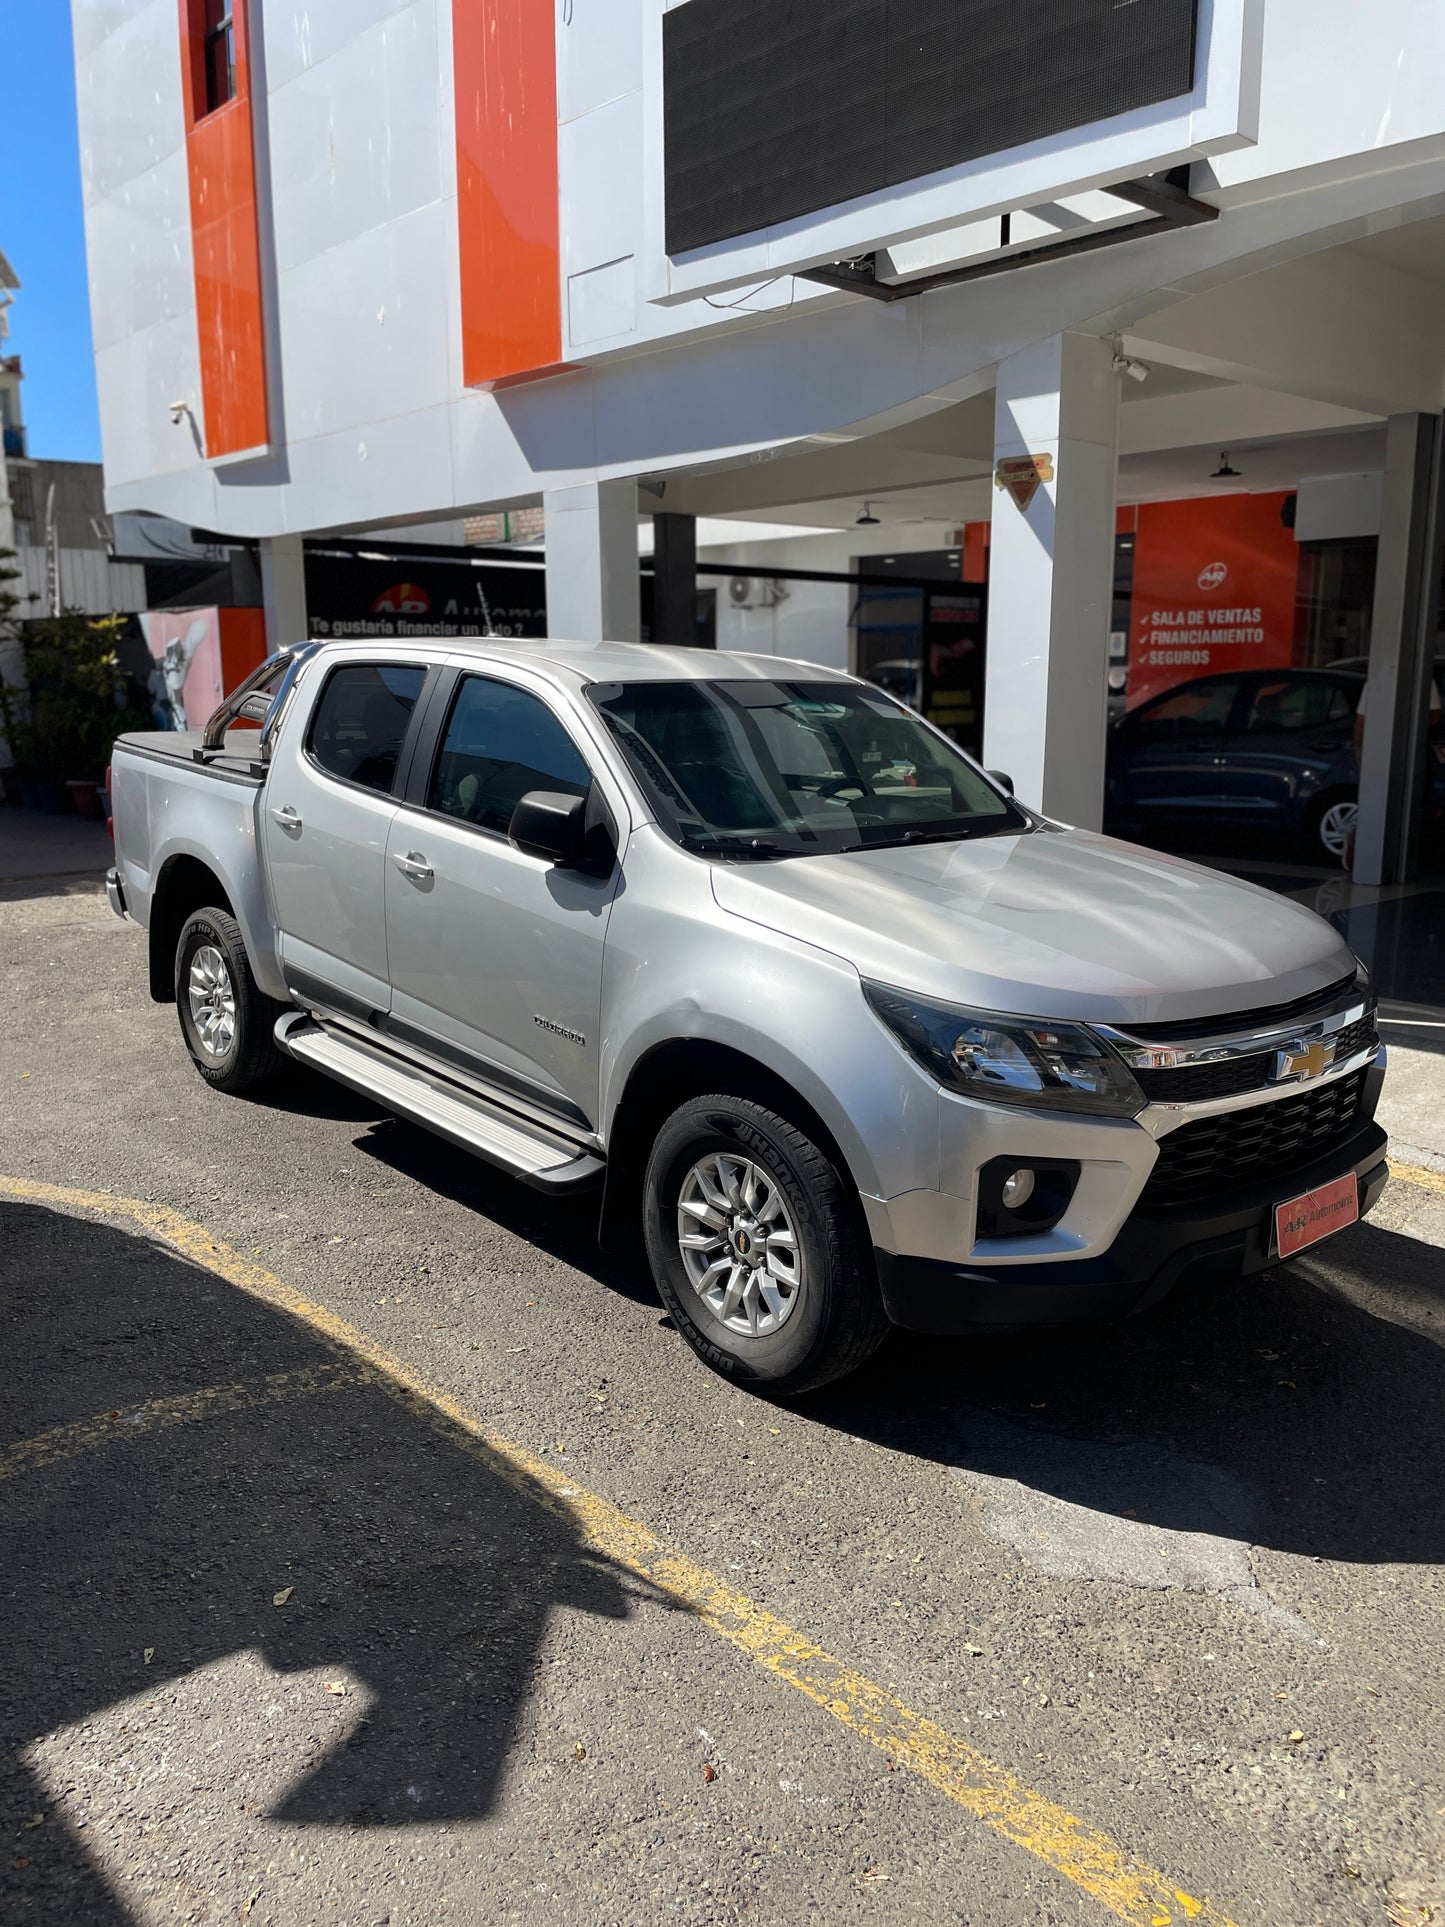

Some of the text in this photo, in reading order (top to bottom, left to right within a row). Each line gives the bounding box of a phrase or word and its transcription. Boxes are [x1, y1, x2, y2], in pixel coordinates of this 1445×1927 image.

[1151, 607, 1262, 626] SALA DE VENTAS
[310, 617, 329, 633] Te
[332, 618, 393, 636] gustaría
[397, 620, 458, 636] financiar
[462, 624, 479, 636] un
[1150, 628, 1264, 645] FINANCIAMIENTO
[1149, 650, 1210, 665] SEGUROS
[1310, 1195, 1353, 1222] Automotriz
